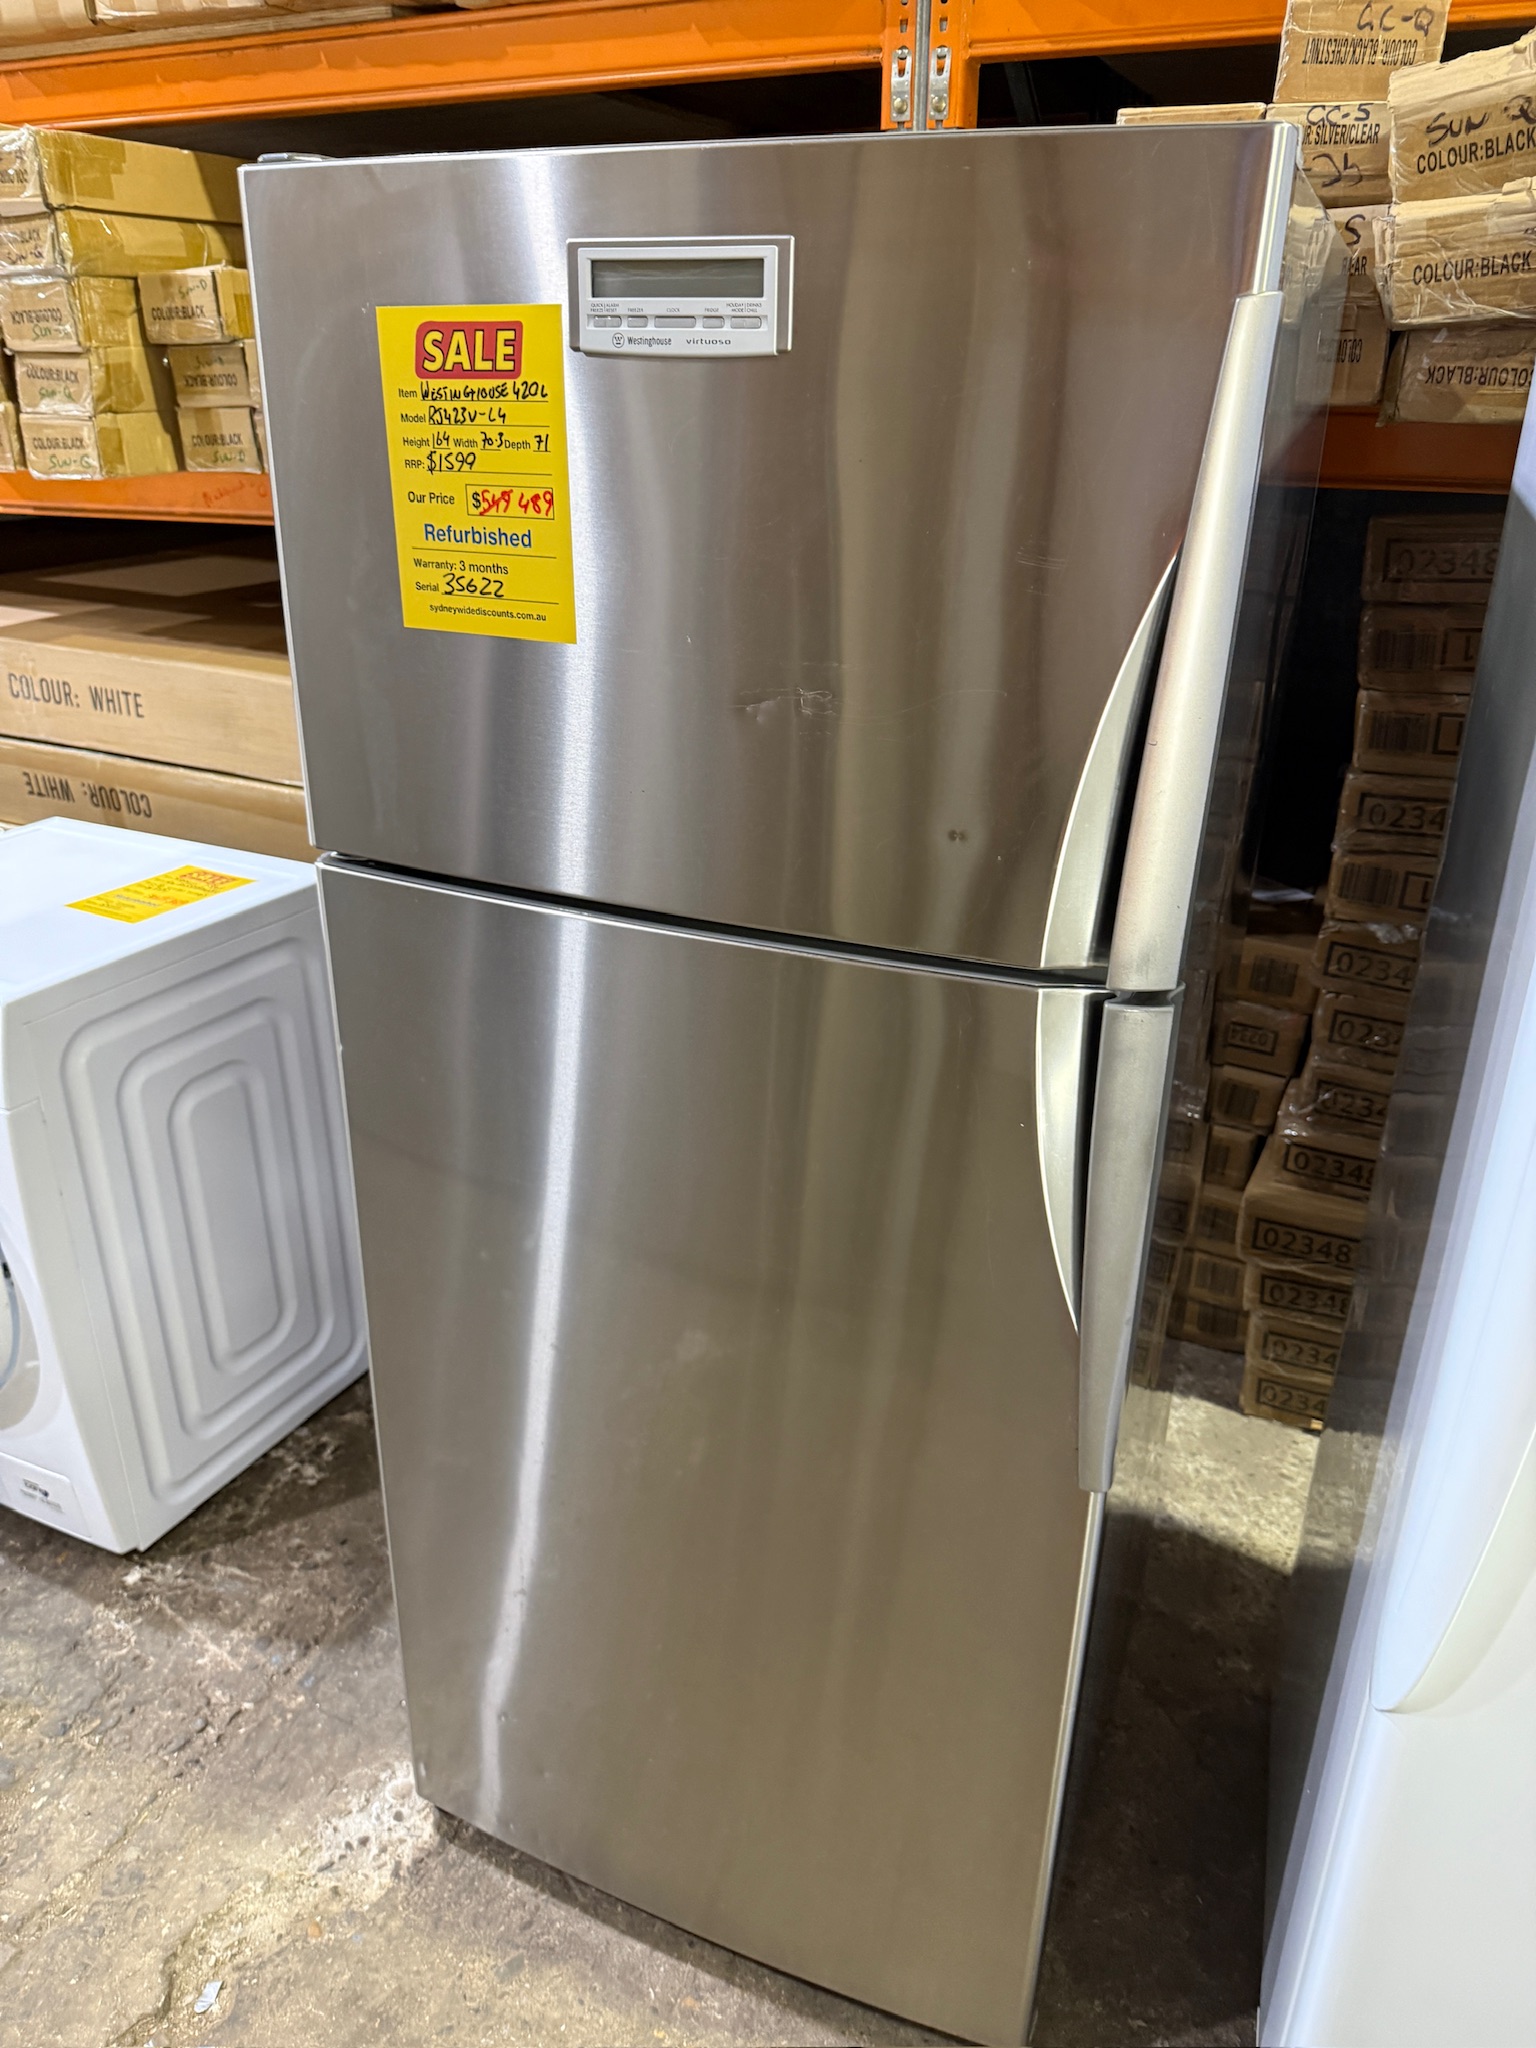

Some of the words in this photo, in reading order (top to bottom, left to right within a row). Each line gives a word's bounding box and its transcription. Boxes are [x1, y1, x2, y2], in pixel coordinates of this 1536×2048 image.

[1314, 123, 1380, 146] SILVER/CLEAR
[1417, 126, 1536, 175] COLOUR:BLACK
[1413, 250, 1532, 286] COLOUR:BLACK
[151, 305, 206, 320] COLOUR:BLACK
[422, 328, 517, 373] SALE
[627, 335, 672, 348] Westinghouse
[686, 337, 732, 345] virtuoso
[398, 388, 418, 398] Item
[401, 413, 427, 424] Model
[402, 436, 430, 448] Height
[453, 438, 478, 449] Width
[504, 439, 531, 450] Depth
[404, 459, 425, 469] RRP:
[426, 451, 477, 475] $1599
[407, 491, 426, 504] Our
[429, 492, 455, 505] Price
[424, 523, 532, 549] Refurbished
[413, 558, 457, 572] Warranty:
[459, 561, 466, 572] 3
[468, 563, 509, 575] months
[415, 581, 439, 592] Serial
[429, 603, 547, 622] sydneywidediscounts.com.au
[8, 673, 80, 708] COLOUR:
[89, 685, 145, 718] WHITE
[23, 771, 75, 803] WHITE
[82, 781, 152, 818] COLOUR:
[1263, 1227, 1351, 1264] 02348
